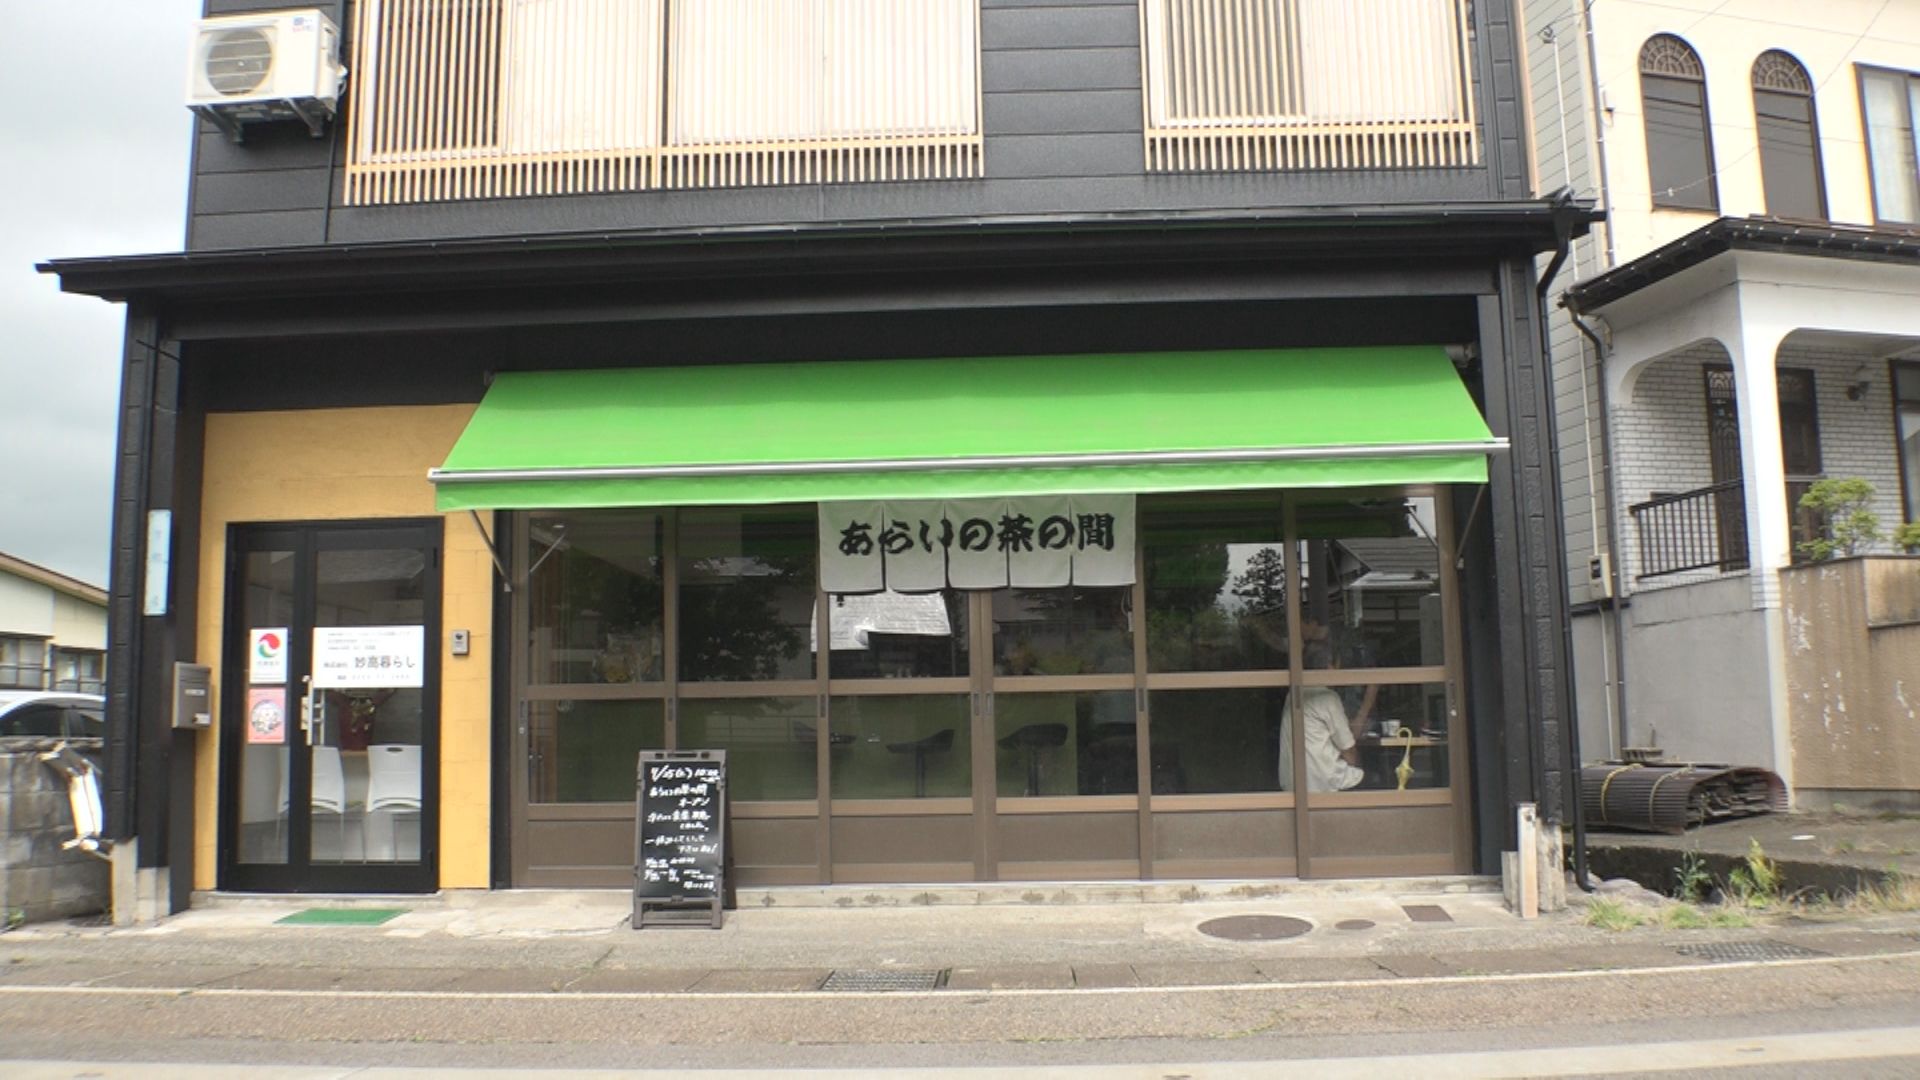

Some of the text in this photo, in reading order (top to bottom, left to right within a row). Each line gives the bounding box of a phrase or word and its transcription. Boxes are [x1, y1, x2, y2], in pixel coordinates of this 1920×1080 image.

[838, 512, 1115, 556] あらいの茶の間
